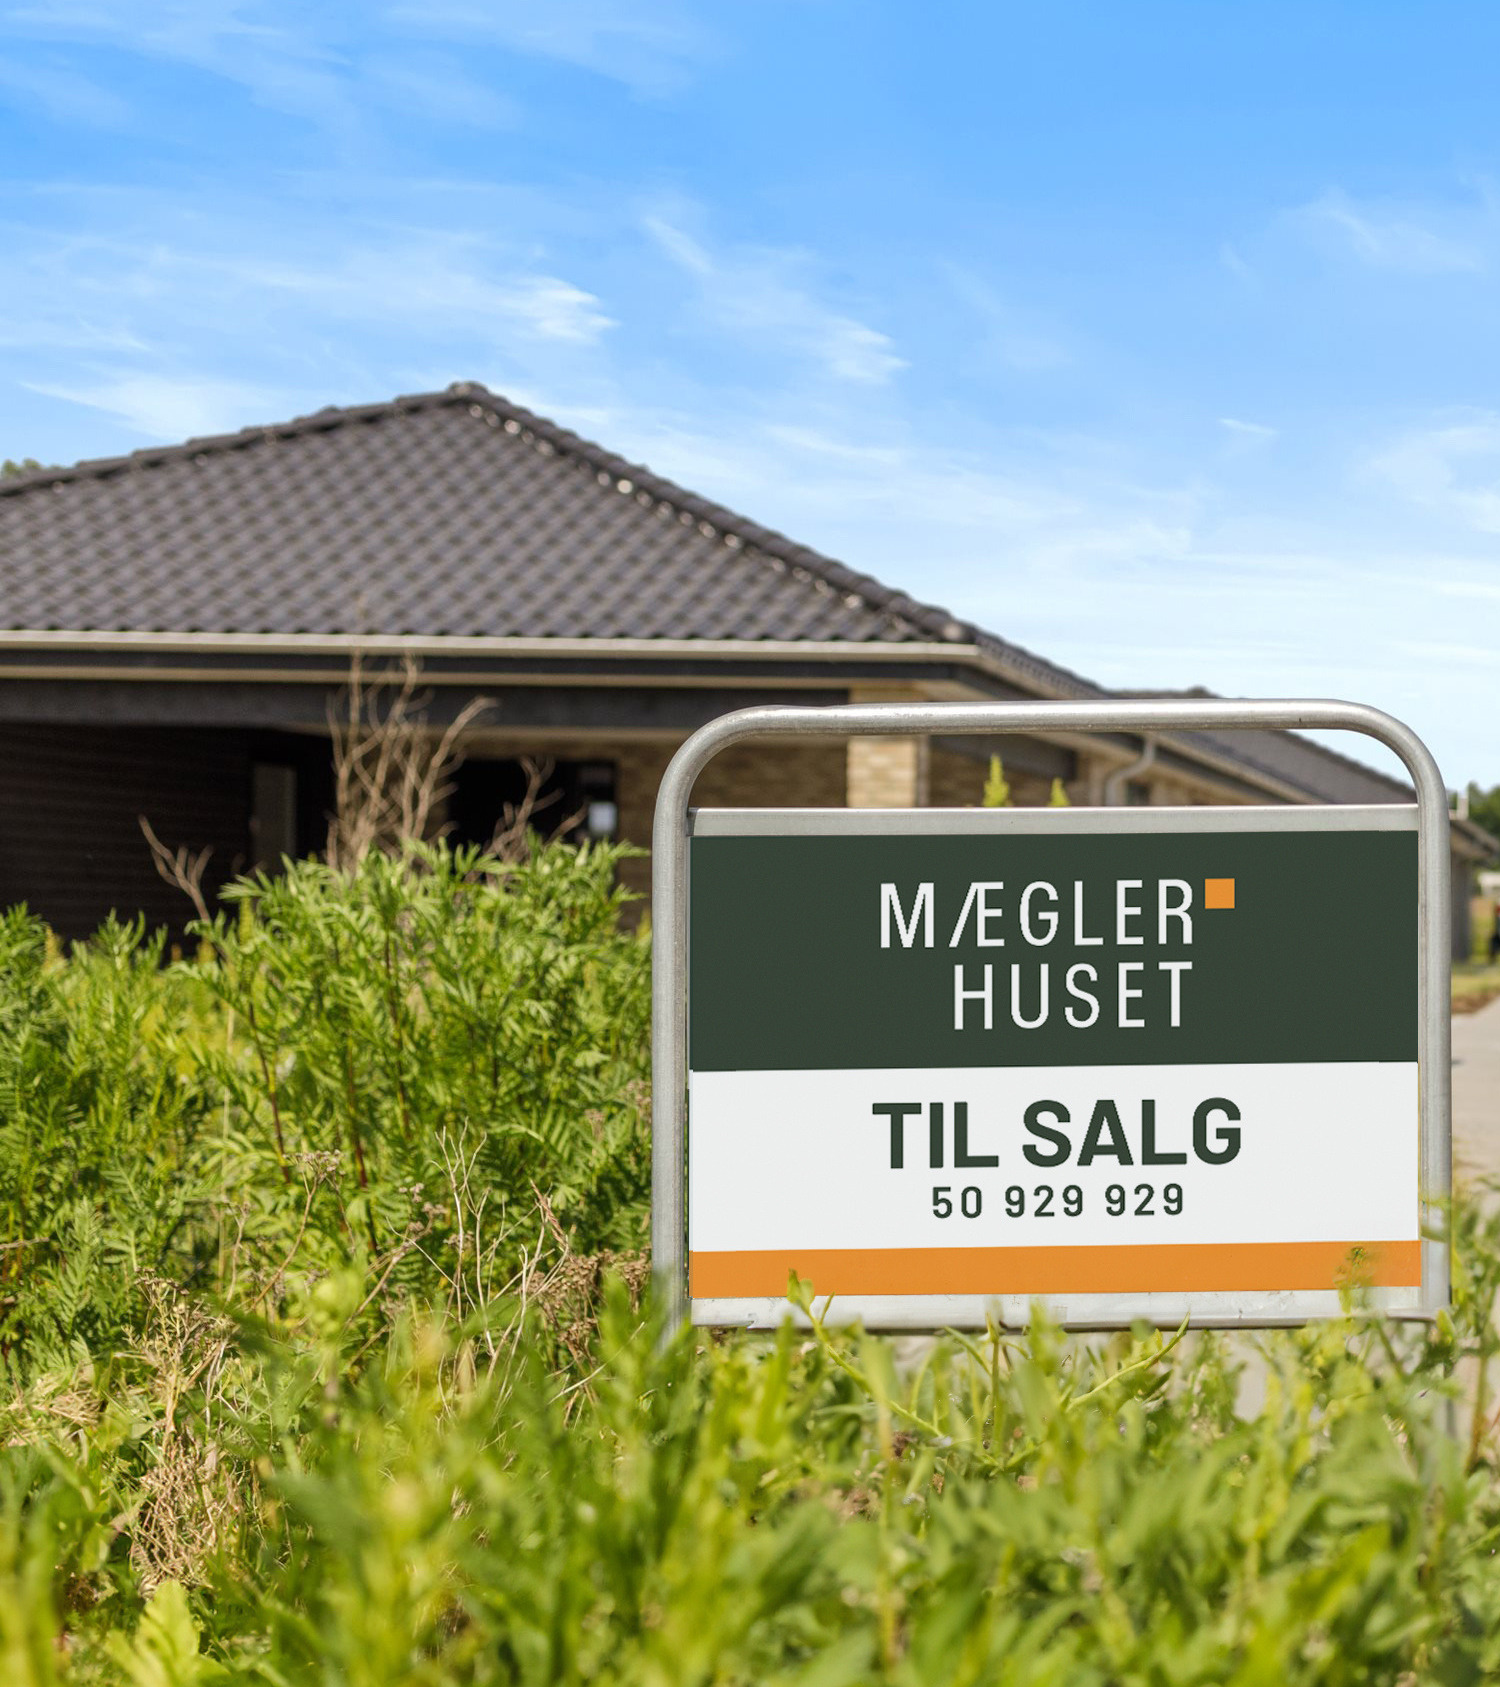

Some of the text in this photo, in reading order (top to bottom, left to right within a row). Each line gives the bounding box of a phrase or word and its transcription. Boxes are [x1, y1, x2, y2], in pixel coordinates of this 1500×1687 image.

[880, 879, 1193, 948] MÆGLER
[954, 962, 1193, 1030] HUSET
[871, 1097, 1242, 1169] TIL SALG
[932, 1184, 1183, 1219] 50 929 929
